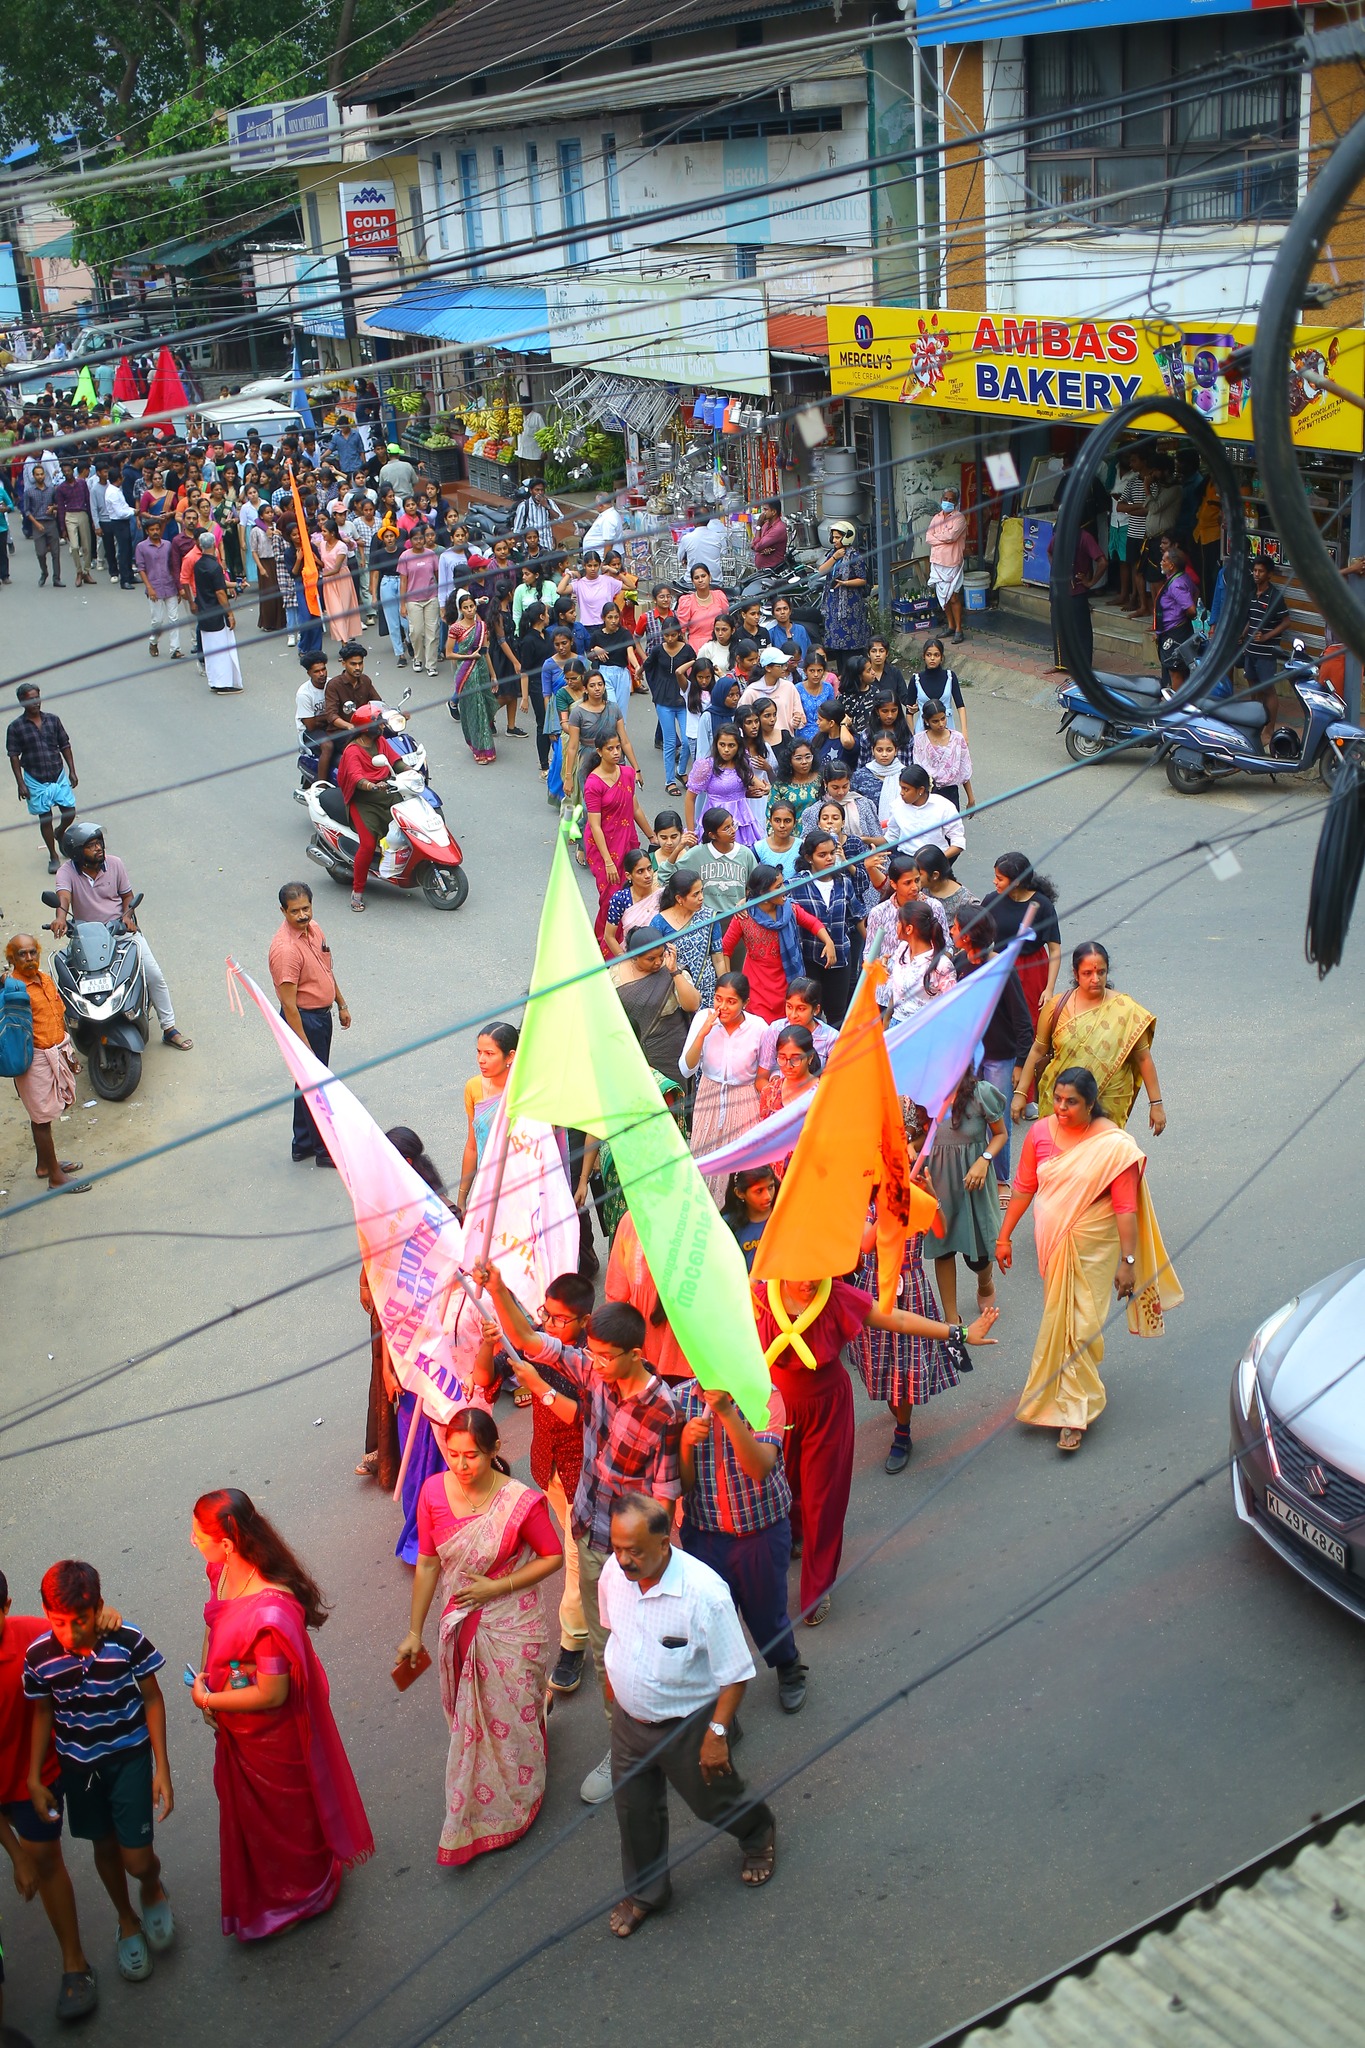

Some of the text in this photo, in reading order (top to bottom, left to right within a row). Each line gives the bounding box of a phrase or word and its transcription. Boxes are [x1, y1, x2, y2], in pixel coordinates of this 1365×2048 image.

[726, 166, 766, 187] REKHA
[814, 200, 867, 221] PLASTICS
[353, 216, 390, 228] GOLD
[354, 230, 390, 242] LOAN
[972, 316, 1138, 363] AMBAS
[839, 351, 892, 371] MERCELY'S
[852, 371, 881, 381] ICE CREAM
[975, 363, 1143, 412] BAKERY
